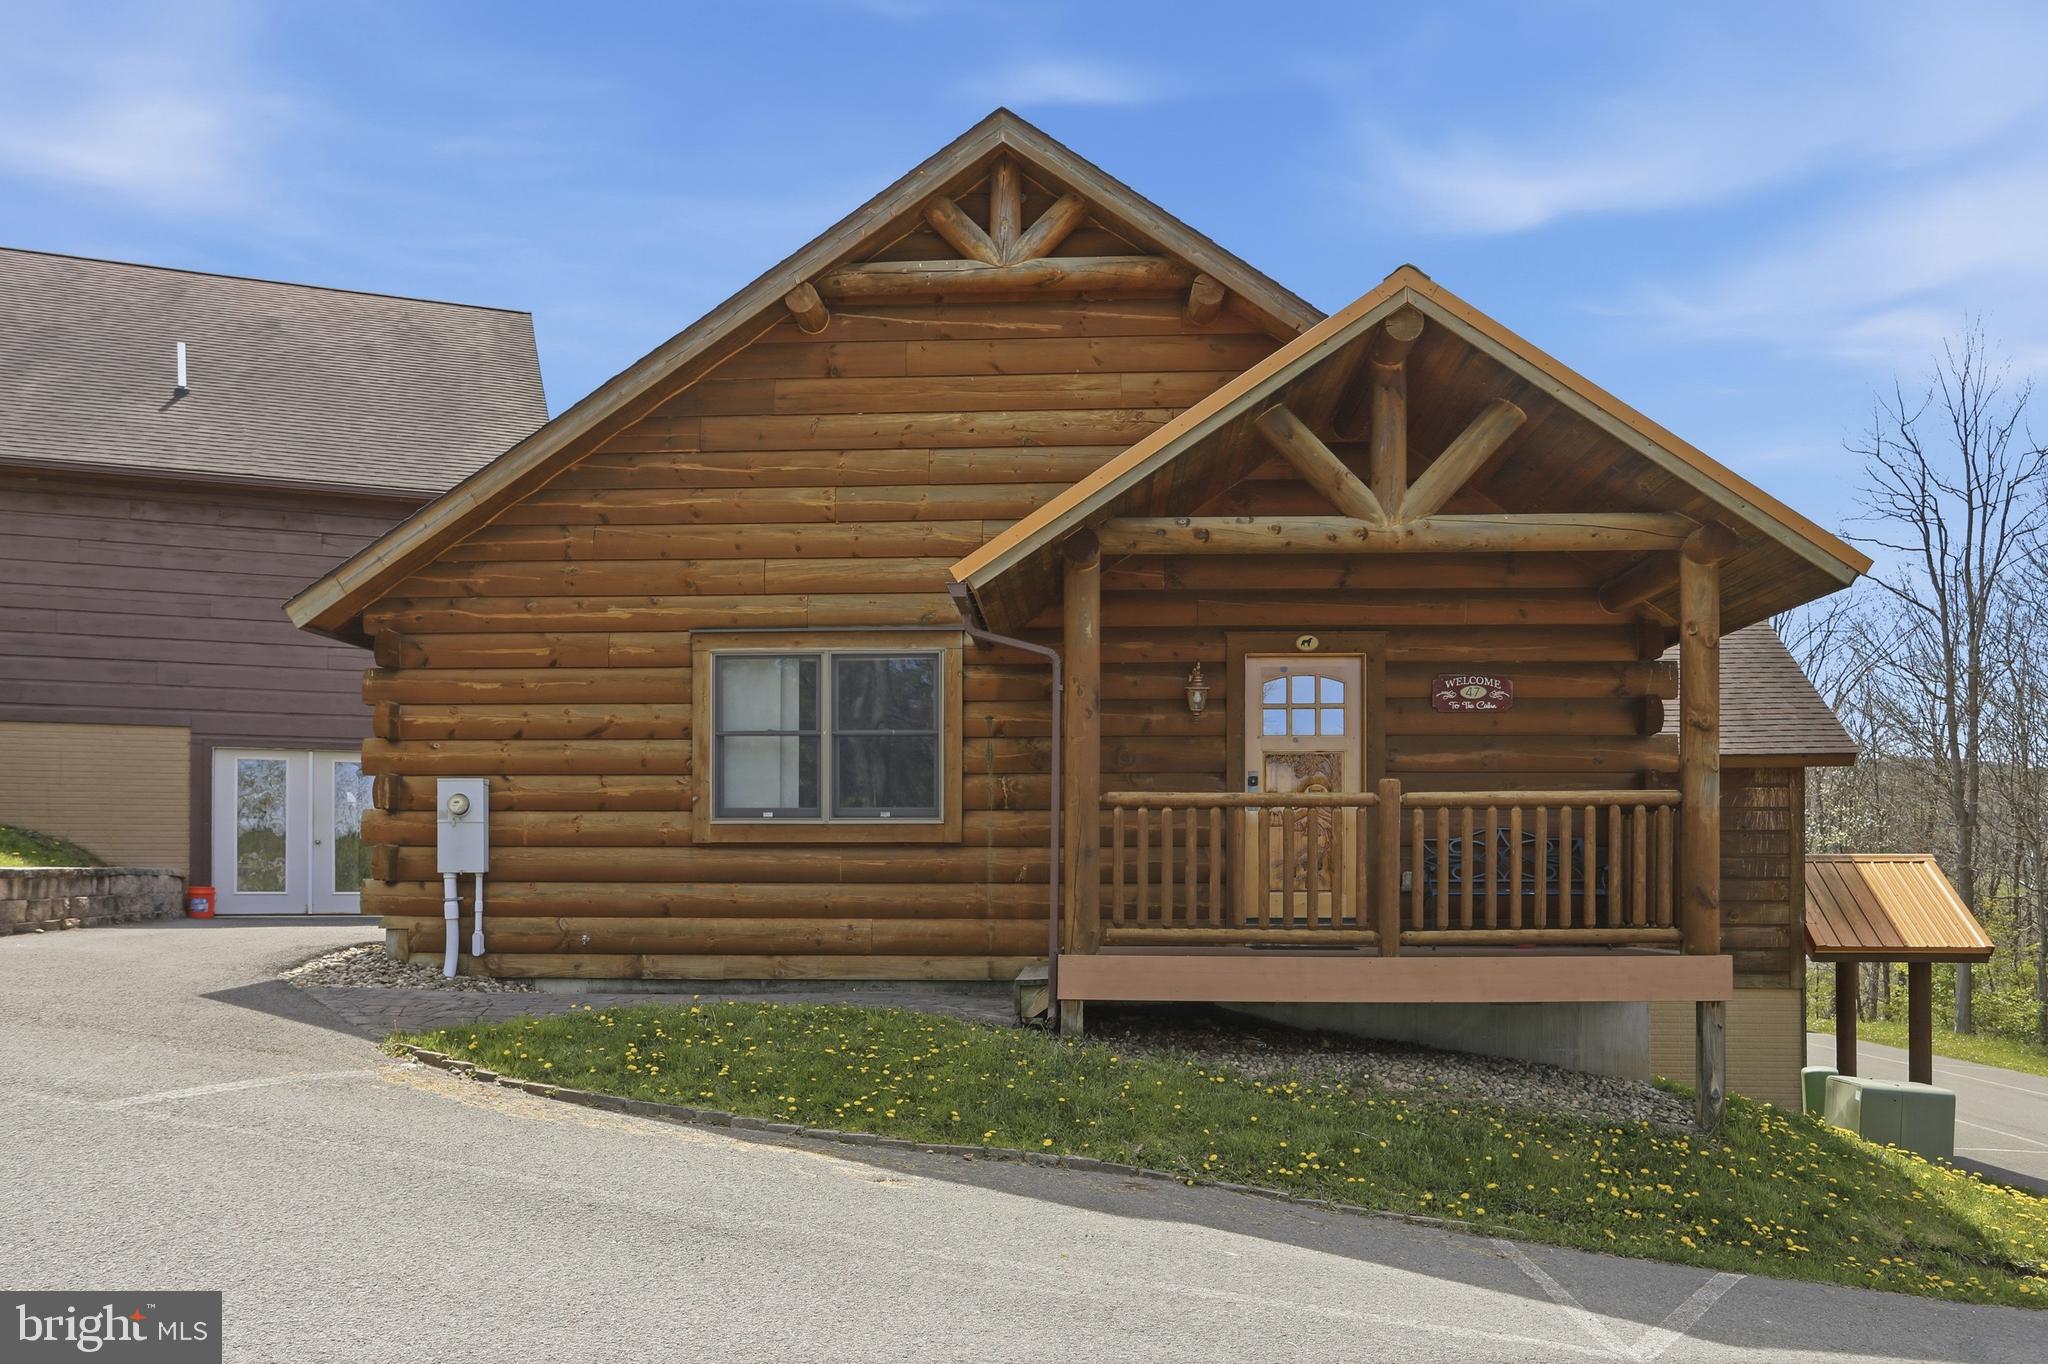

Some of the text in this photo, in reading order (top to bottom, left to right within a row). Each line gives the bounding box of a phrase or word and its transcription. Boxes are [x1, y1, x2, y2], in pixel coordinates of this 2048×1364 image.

[1445, 676, 1501, 689] WELCOME
[1465, 687, 1481, 697] 47
[1449, 701, 1460, 709] To
